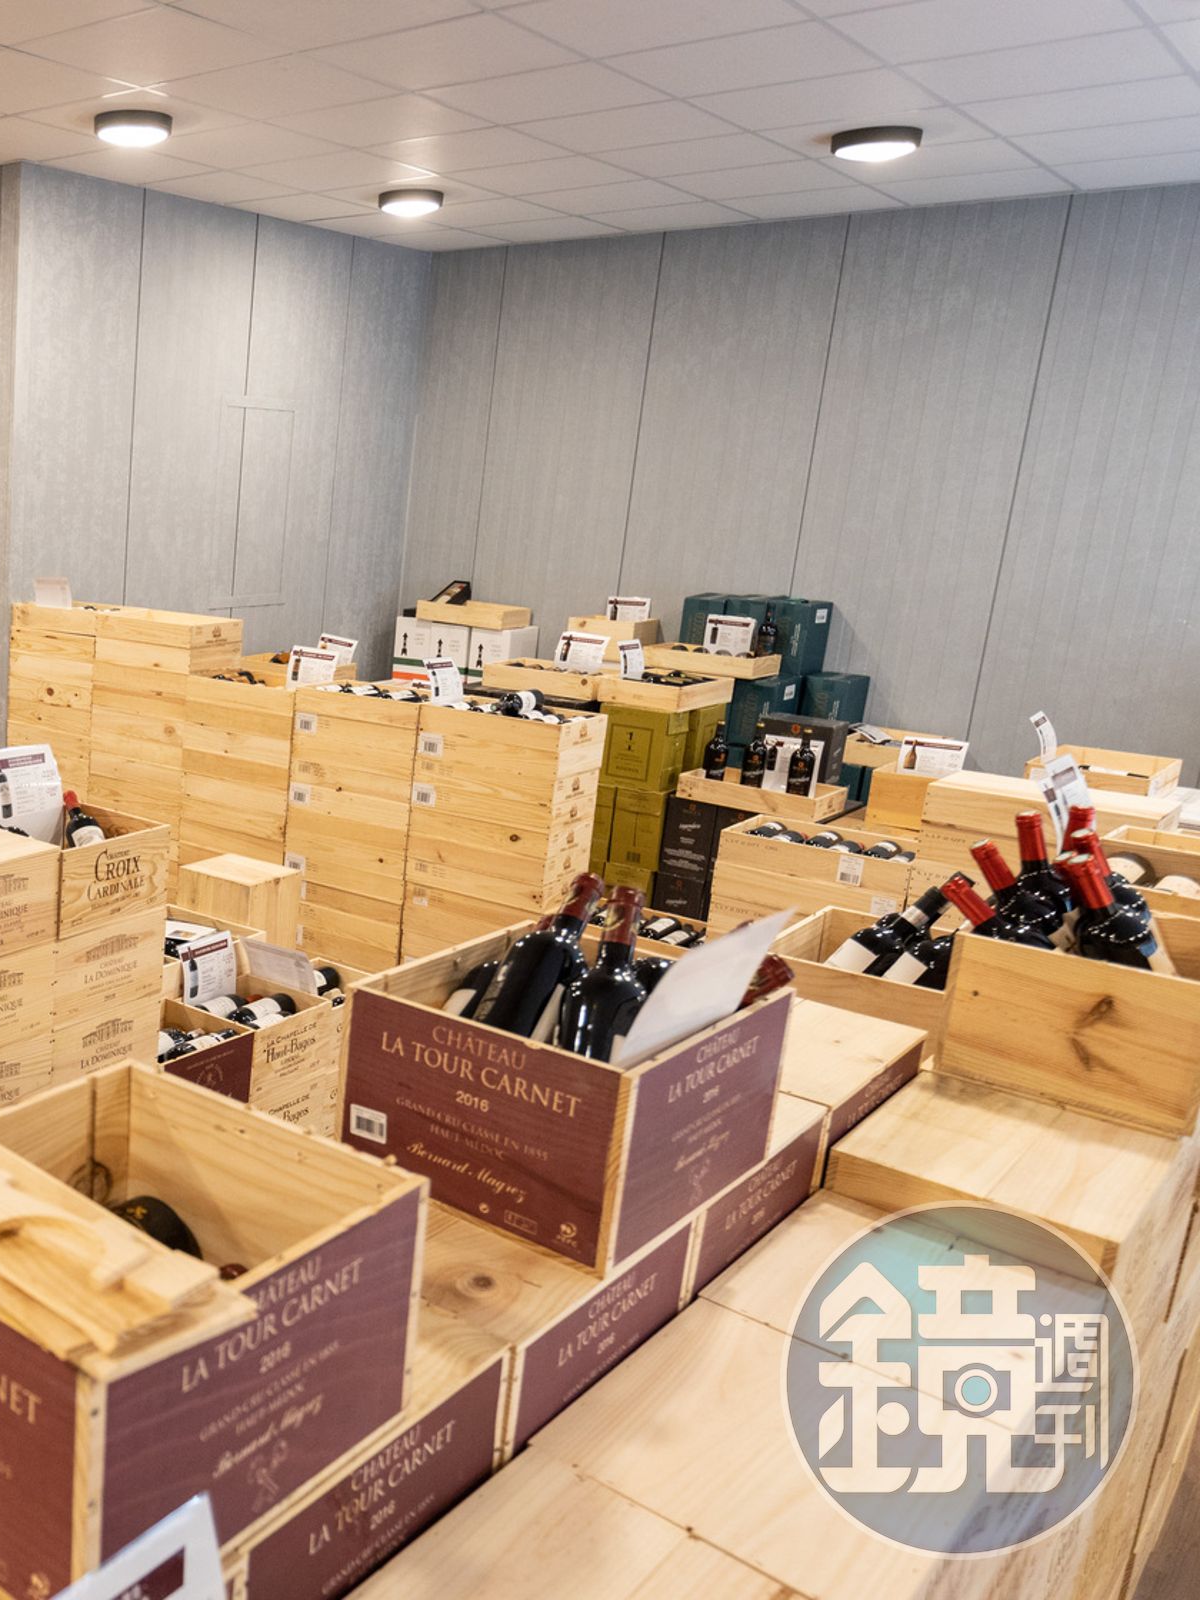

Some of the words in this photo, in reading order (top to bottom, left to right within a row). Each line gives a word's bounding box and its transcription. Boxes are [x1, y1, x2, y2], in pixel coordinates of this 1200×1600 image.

[94, 848, 141, 882] CROIX
[380, 1031, 405, 1057] LA
[411, 1041, 475, 1082] TOUR
[480, 1066, 582, 1118] CARNET
[432, 1025, 528, 1071] CHÂTEAU
[454, 1089, 490, 1113] 2016
[667, 1081, 682, 1104] LA
[684, 1062, 717, 1094] TOUR
[181, 1358, 209, 1393] LA
[213, 1312, 276, 1371] TOUR
[280, 1257, 366, 1328] CARNET
[556, 1347, 574, 1369] LA
[575, 1315, 610, 1347] TOUR
[609, 1272, 660, 1324] CARNET
[308, 1525, 331, 1557] LA
[334, 1482, 385, 1533] TOUR
[387, 1420, 457, 1489] CARNET
